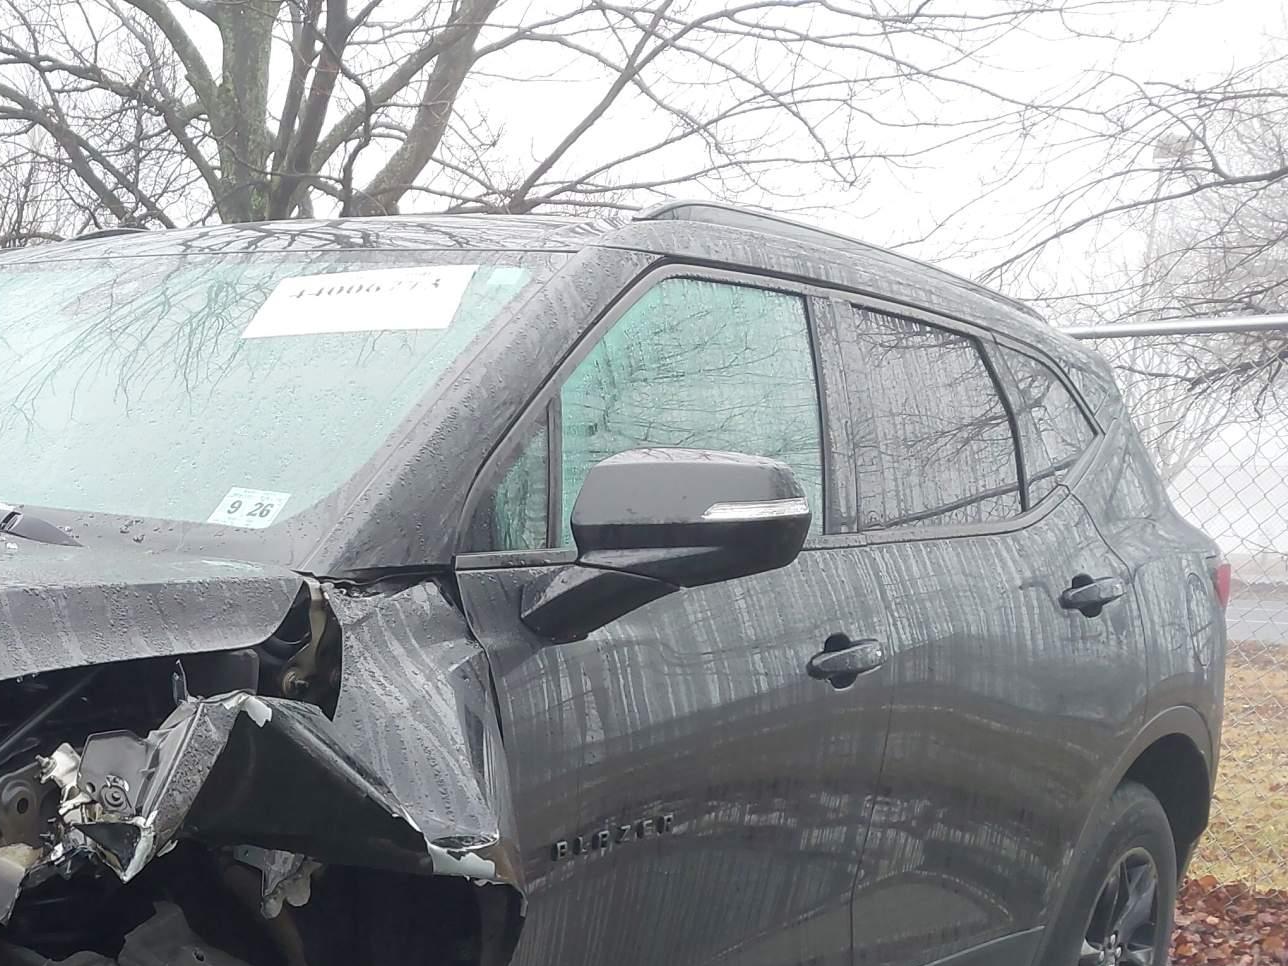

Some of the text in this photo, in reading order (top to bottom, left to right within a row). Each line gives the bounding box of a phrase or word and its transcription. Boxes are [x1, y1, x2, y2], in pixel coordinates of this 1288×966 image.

[226, 499, 275, 518] 9 26
[553, 813, 675, 861] BLAZER
